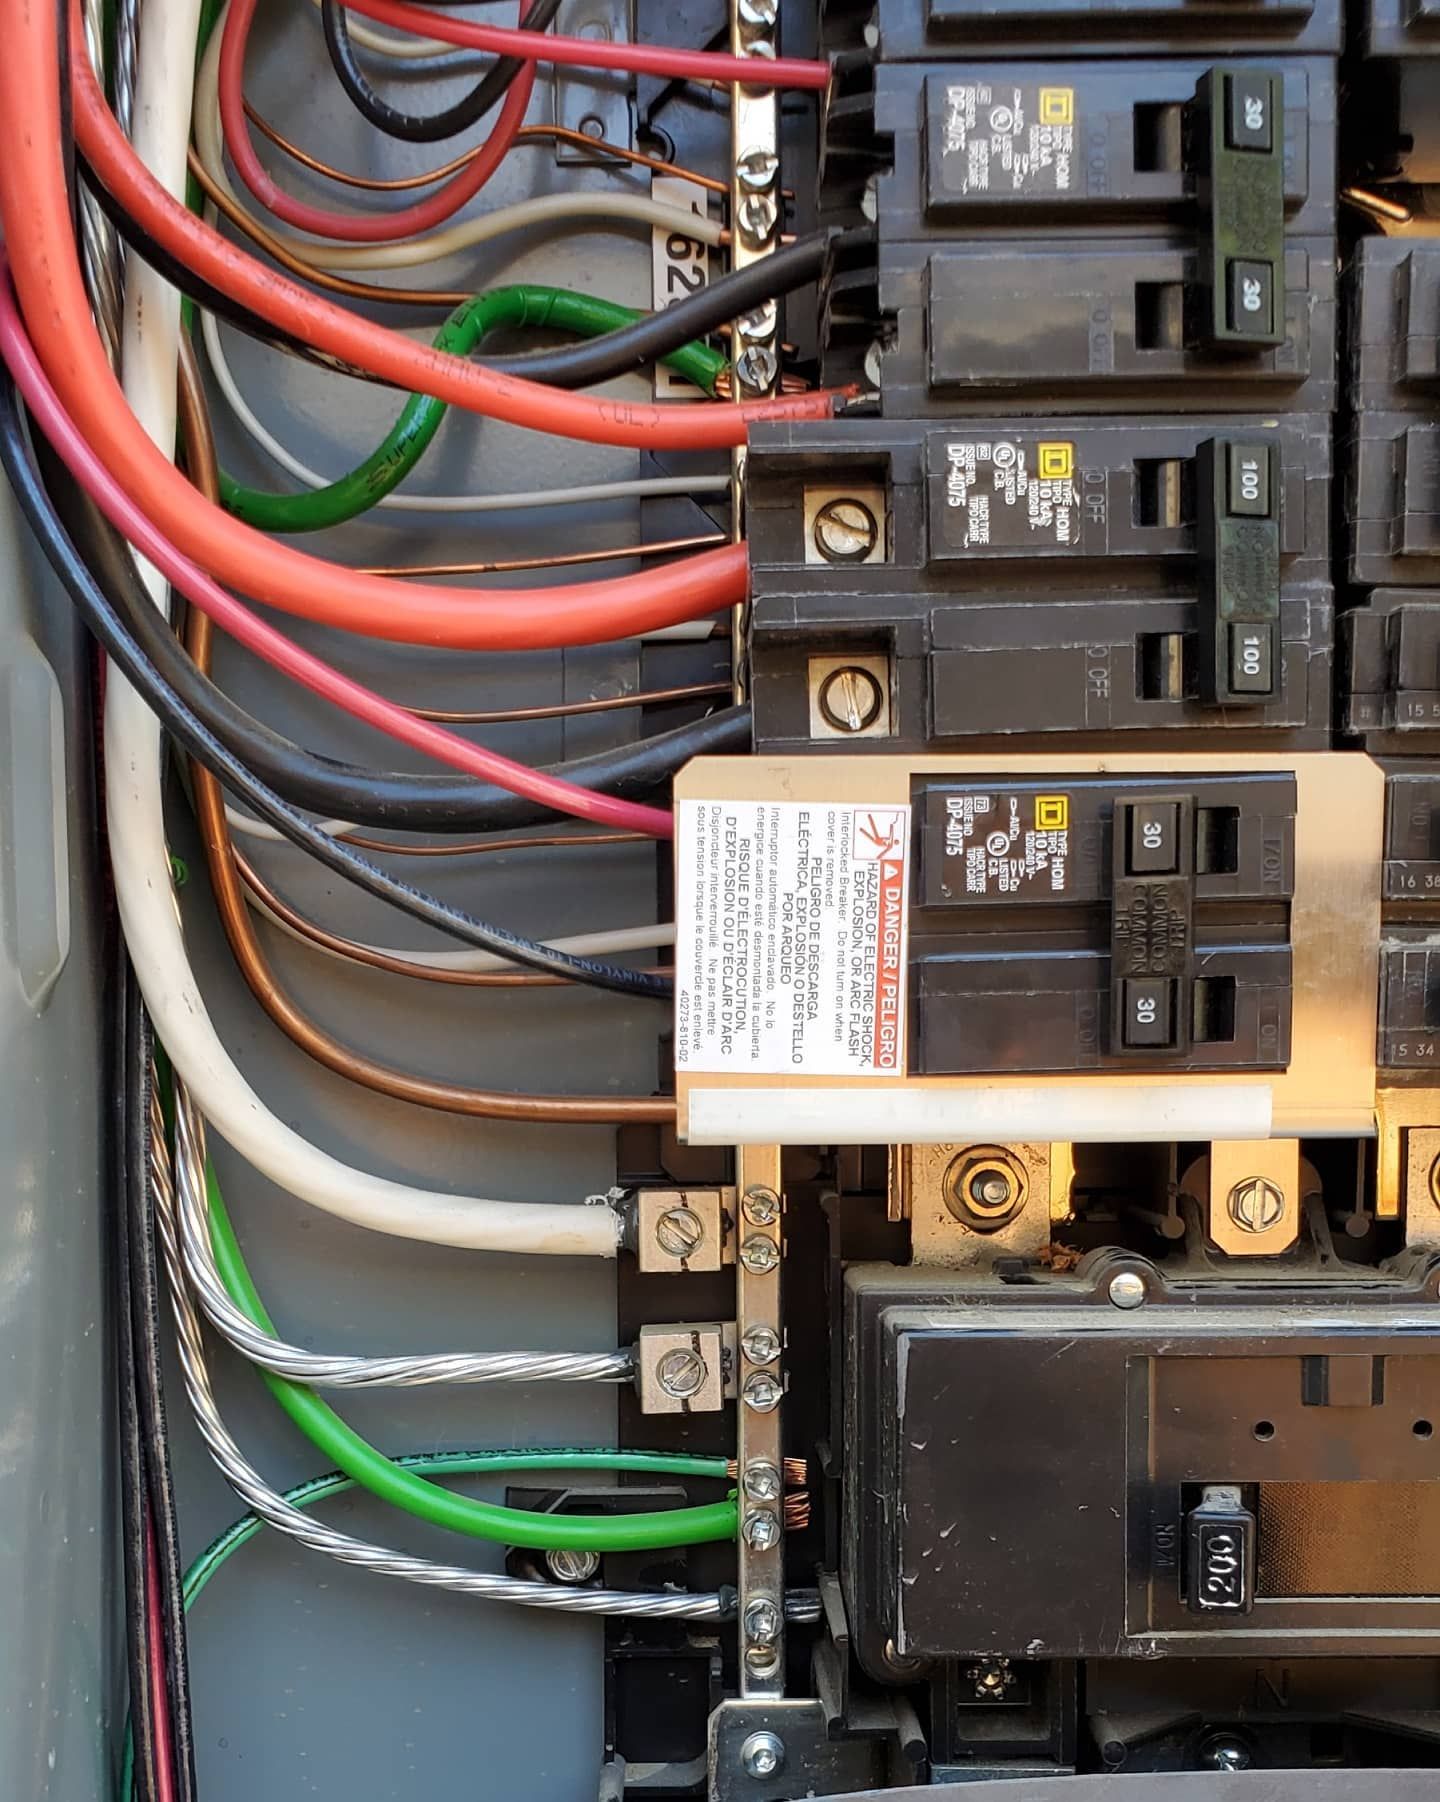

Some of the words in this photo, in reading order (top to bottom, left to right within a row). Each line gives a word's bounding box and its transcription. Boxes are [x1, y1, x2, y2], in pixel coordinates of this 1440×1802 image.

[1245, 96, 1263, 129] 30
[1040, 126, 1051, 144] 10
[1243, 278, 1261, 311] 30
[965, 445, 975, 470] ISSUE
[948, 445, 965, 506] DP-4075
[994, 471, 1004, 490] C.B.
[1005, 472, 1015, 505] LISTED
[1040, 481, 1051, 498] 10
[1241, 460, 1258, 500] 100
[1029, 480, 1038, 516] 120/240
[1052, 480, 1061, 503] TIPO
[1062, 480, 1072, 505] TYPE
[969, 497, 978, 516] TIPO
[978, 496, 988, 521] HACR
[1040, 501, 1052, 518] kA
[1086, 495, 1104, 524] OFF
[969, 517, 978, 542] CARR
[978, 522, 988, 544] TYPE
[1057, 509, 1069, 541] HOM
[1244, 636, 1260, 674] 100
[1088, 669, 1108, 698] OFF
[1408, 704, 1424, 717] 15
[697, 806, 705, 832] sous
[963, 797, 973, 823] ISSUE
[709, 807, 721, 870] Disjoncteur
[755, 807, 765, 854] energice
[769, 807, 780, 866] Interruptor
[946, 798, 963, 855] DP-4075
[1036, 831, 1047, 848] 10
[1143, 822, 1162, 848] 30
[796, 812, 812, 893] ELÉCTRICA,
[827, 846, 835, 854] is
[840, 812, 851, 873] Interlocked
[1025, 831, 1035, 865] 120/240
[1048, 831, 1057, 853] TIPO
[1057, 831, 1068, 856] TYPE
[697, 837, 706, 877] tension
[724, 817, 736, 912] D'EXPLOSION
[738, 839, 750, 892] RISQUE
[966, 848, 975, 867] TIPO
[976, 847, 985, 870] HACR
[988, 858, 998, 878] C.B.
[1036, 851, 1047, 870] kA
[755, 859, 764, 900] cuando
[810, 857, 822, 917] PELIGRO
[825, 858, 834, 909] removed.
[966, 868, 975, 892] CARR
[976, 871, 985, 893] TYPE
[999, 858, 1008, 891] LISTED
[1010, 878, 1019, 891] Cu
[1052, 858, 1064, 890] HOM
[1401, 876, 1416, 888] 16
[694, 881, 705, 921] lorsque
[768, 870, 779, 930] automático
[838, 878, 849, 923] Breaker.
[866, 863, 878, 919] HAZARD
[755, 904, 764, 926] esté
[783, 893, 793, 921] POR
[850, 871, 864, 952] EXPLOSION,
[696, 925, 705, 934] le
[724, 918, 734, 937] OU
[794, 898, 808, 975] EXPLOSIÓN
[810, 922, 820, 940] DE
[838, 932, 847, 946] Do
[866, 923, 876, 942] OF
[883, 888, 900, 968] DANGER
[1132, 883, 1147, 972] COMMON
[695, 938, 704, 990] couvercle
[708, 959, 718, 973] Ne
[734, 898, 751, 1034] D'ÉLECTROCUTION,
[753, 931, 763, 998] desmontada
[781, 925, 792, 984] ARQUEO
[837, 950, 846, 967] not
[851, 957, 861, 976] OR
[707, 978, 716, 997] pas
[722, 943, 736, 1007] D'ÉCLAIR
[795, 980, 805, 989] O
[807, 945, 819, 1020] DESCARGA
[836, 972, 845, 991] turn
[863, 946, 875, 1011] ELECTRIC
[694, 995, 702, 1011] est
[753, 1002, 762, 1011] la
[836, 996, 843, 1008] on
[850, 980, 860, 1008] ARC
[707, 1002, 716, 1035] mettre
[766, 1002, 775, 1016] No
[1137, 997, 1155, 1023] 30
[679, 990, 689, 1062] 40273-810-02
[694, 1015, 703, 1053] enlevé.
[721, 1012, 732, 1054] D'ARC
[752, 1016, 761, 1061] cubierta.
[766, 1020, 775, 1028] lo
[792, 994, 804, 1064] DESTELLO
[834, 1013, 845, 1041] when
[848, 1013, 859, 1056] FLASH
[880, 985, 896, 1067] PELIGRO
[859, 1016, 873, 1066] SHOCK,
[1206, 1536, 1237, 1592] 200
